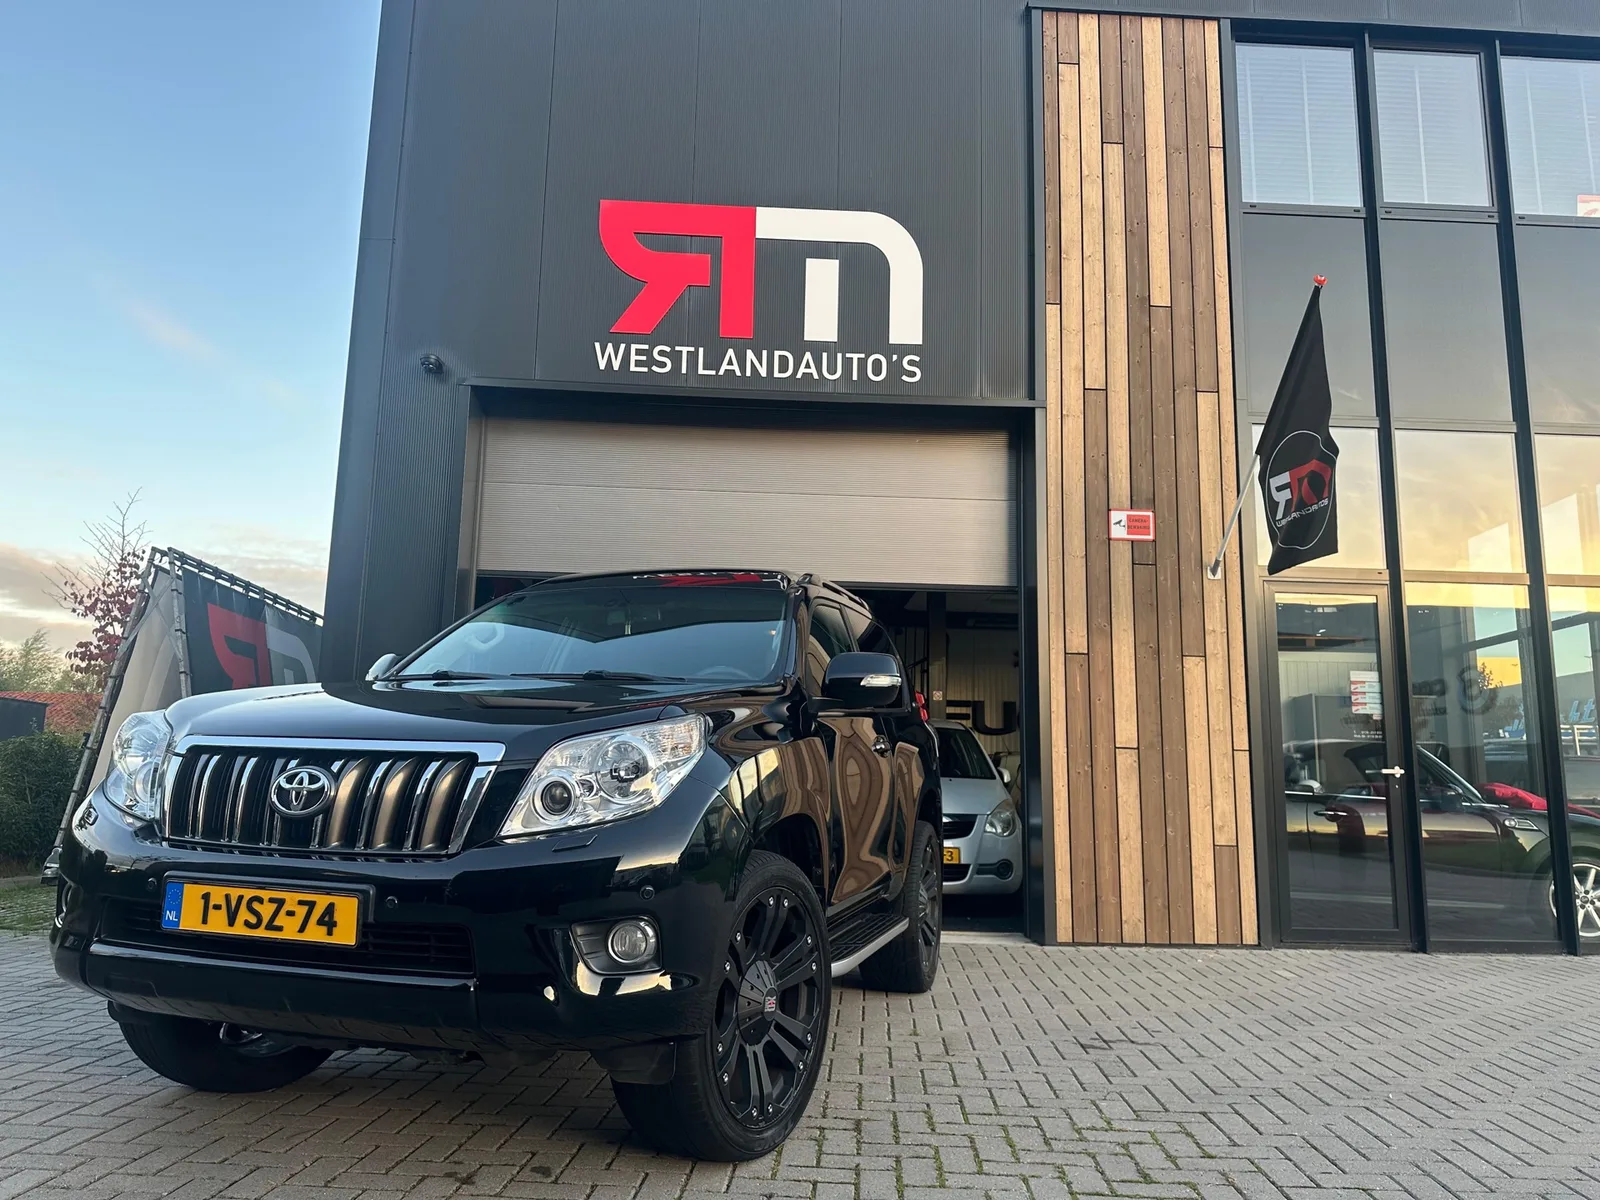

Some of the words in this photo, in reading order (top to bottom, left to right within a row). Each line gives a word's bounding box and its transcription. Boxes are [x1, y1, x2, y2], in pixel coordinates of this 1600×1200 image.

[594, 341, 923, 383] WESTLANDAUTO'S
[165, 910, 179, 922] NL
[200, 891, 338, 937] 1-VSZ-74
